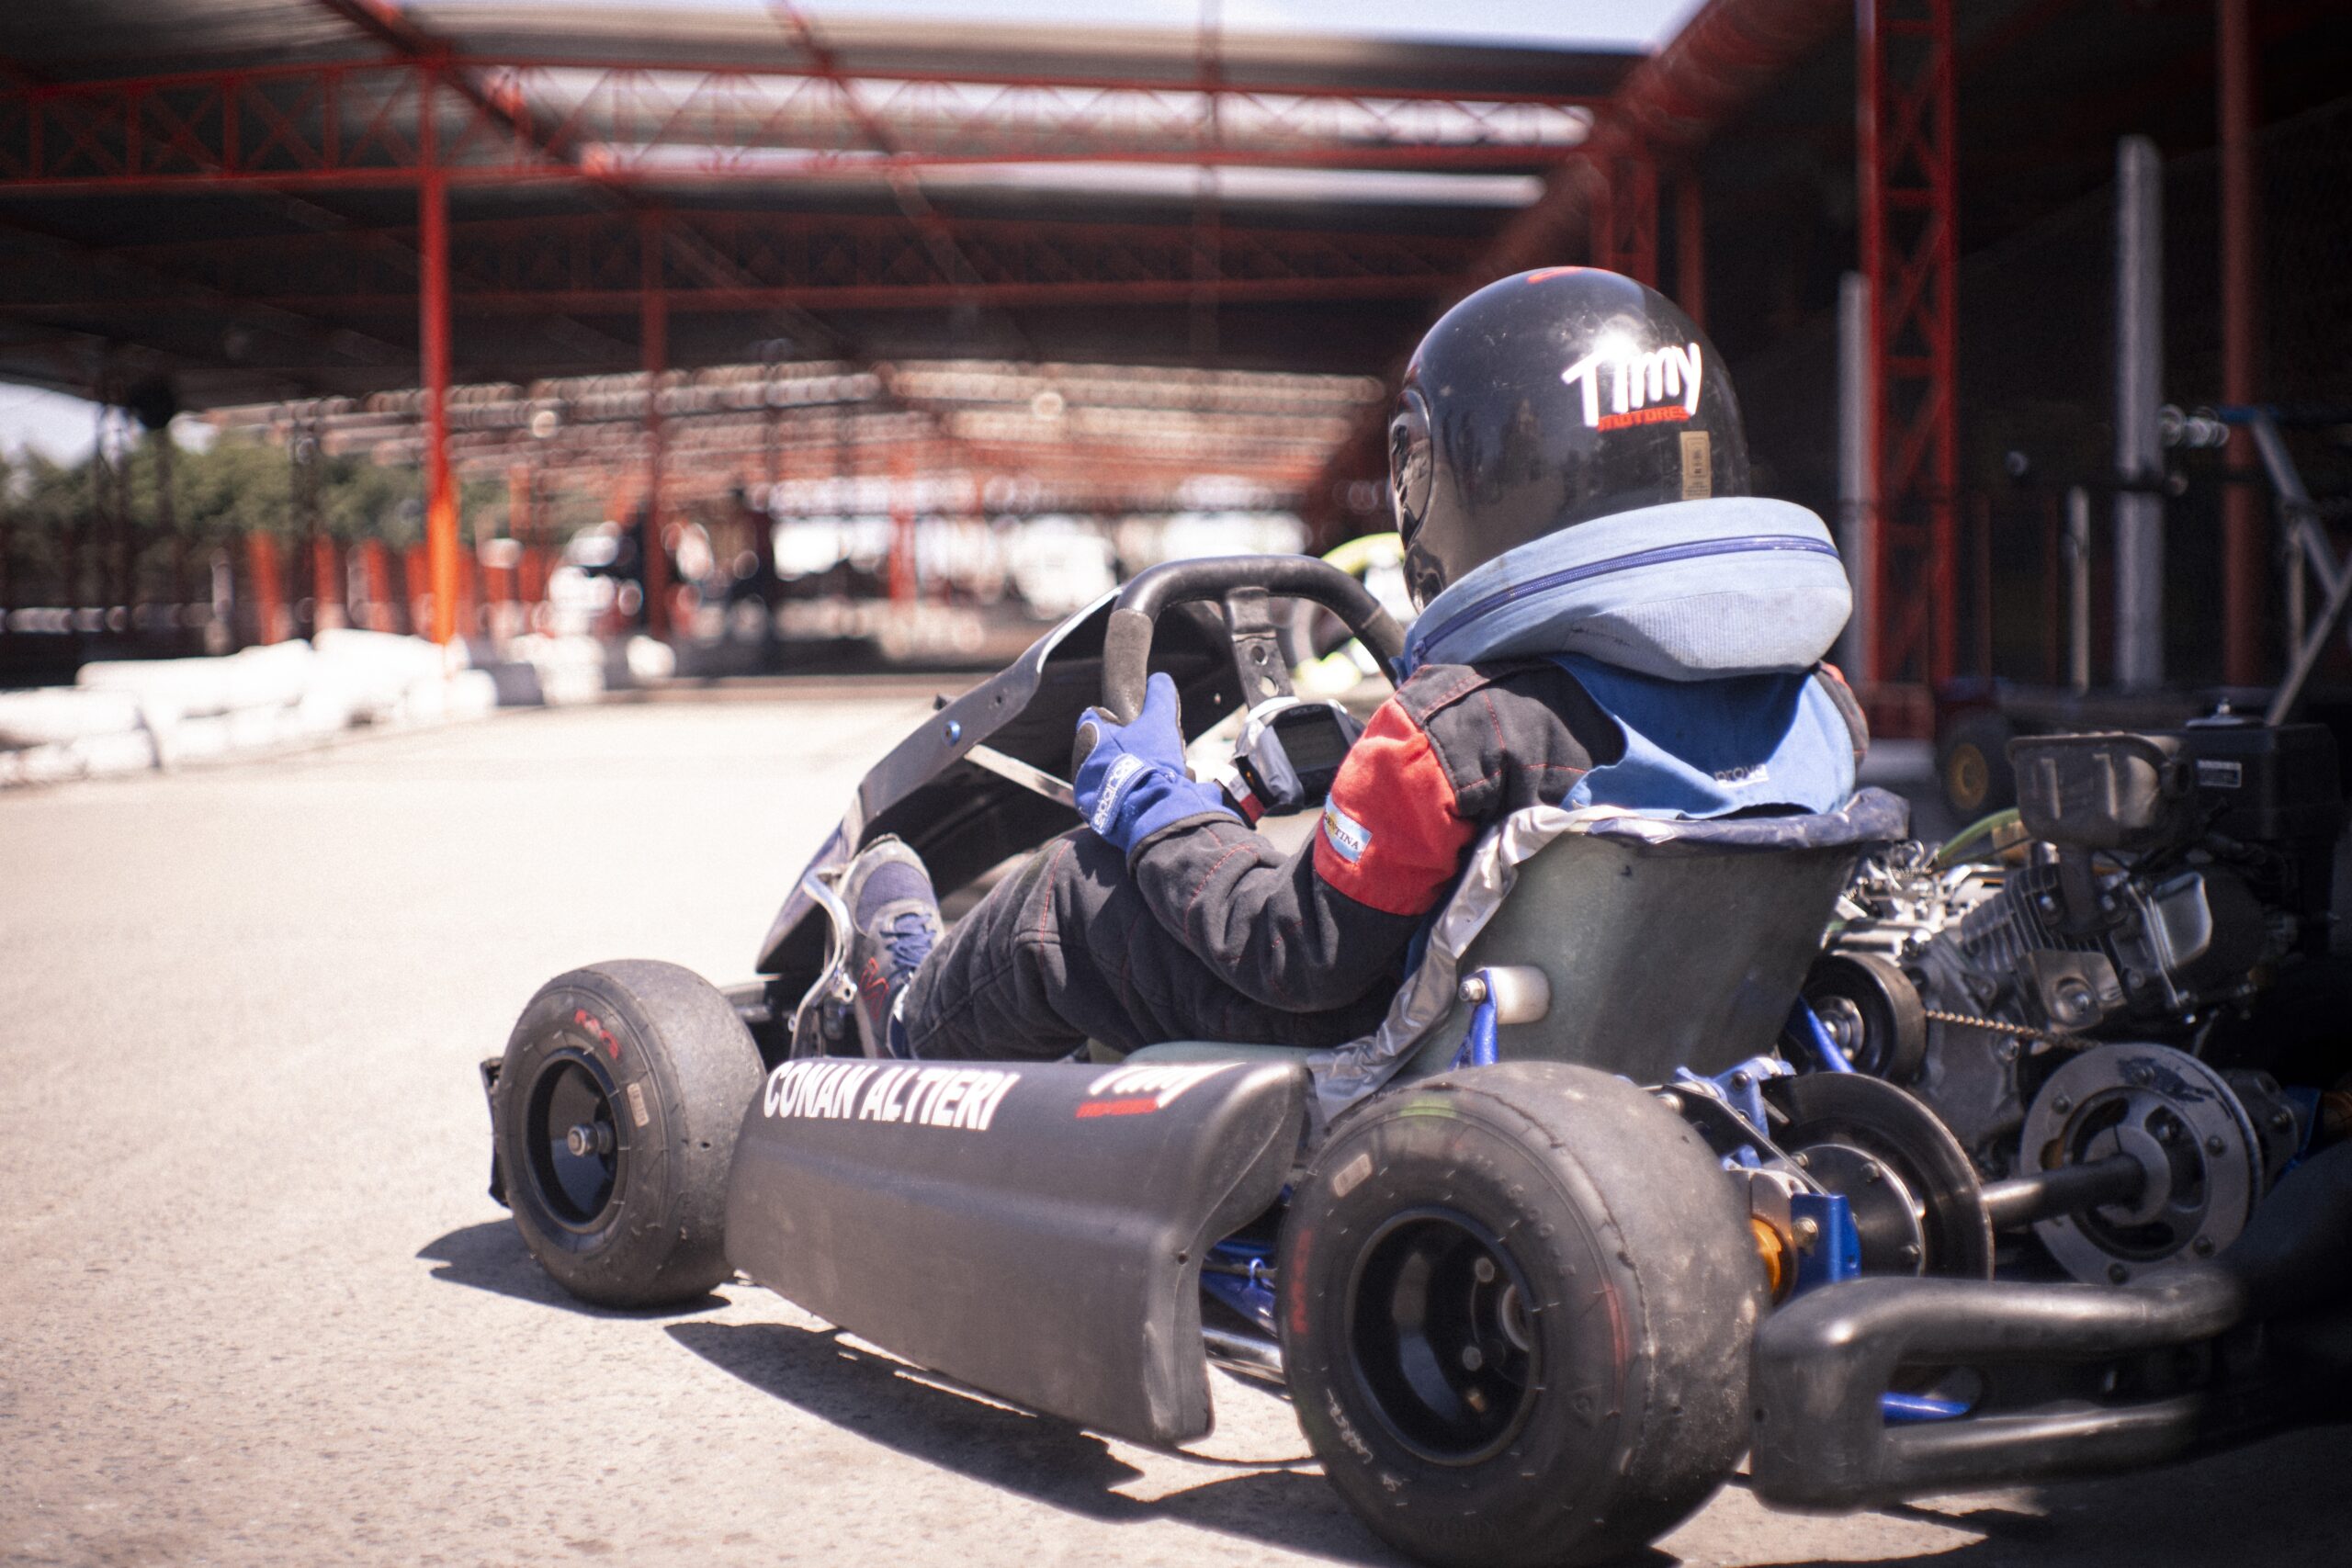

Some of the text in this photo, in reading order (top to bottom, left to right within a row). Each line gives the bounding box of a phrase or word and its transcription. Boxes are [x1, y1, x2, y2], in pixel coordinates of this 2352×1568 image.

[1560, 342, 1702, 429] Timy
[1093, 756, 1138, 829] sparco
[763, 1061, 1020, 1131] CONAN ALTIERI
